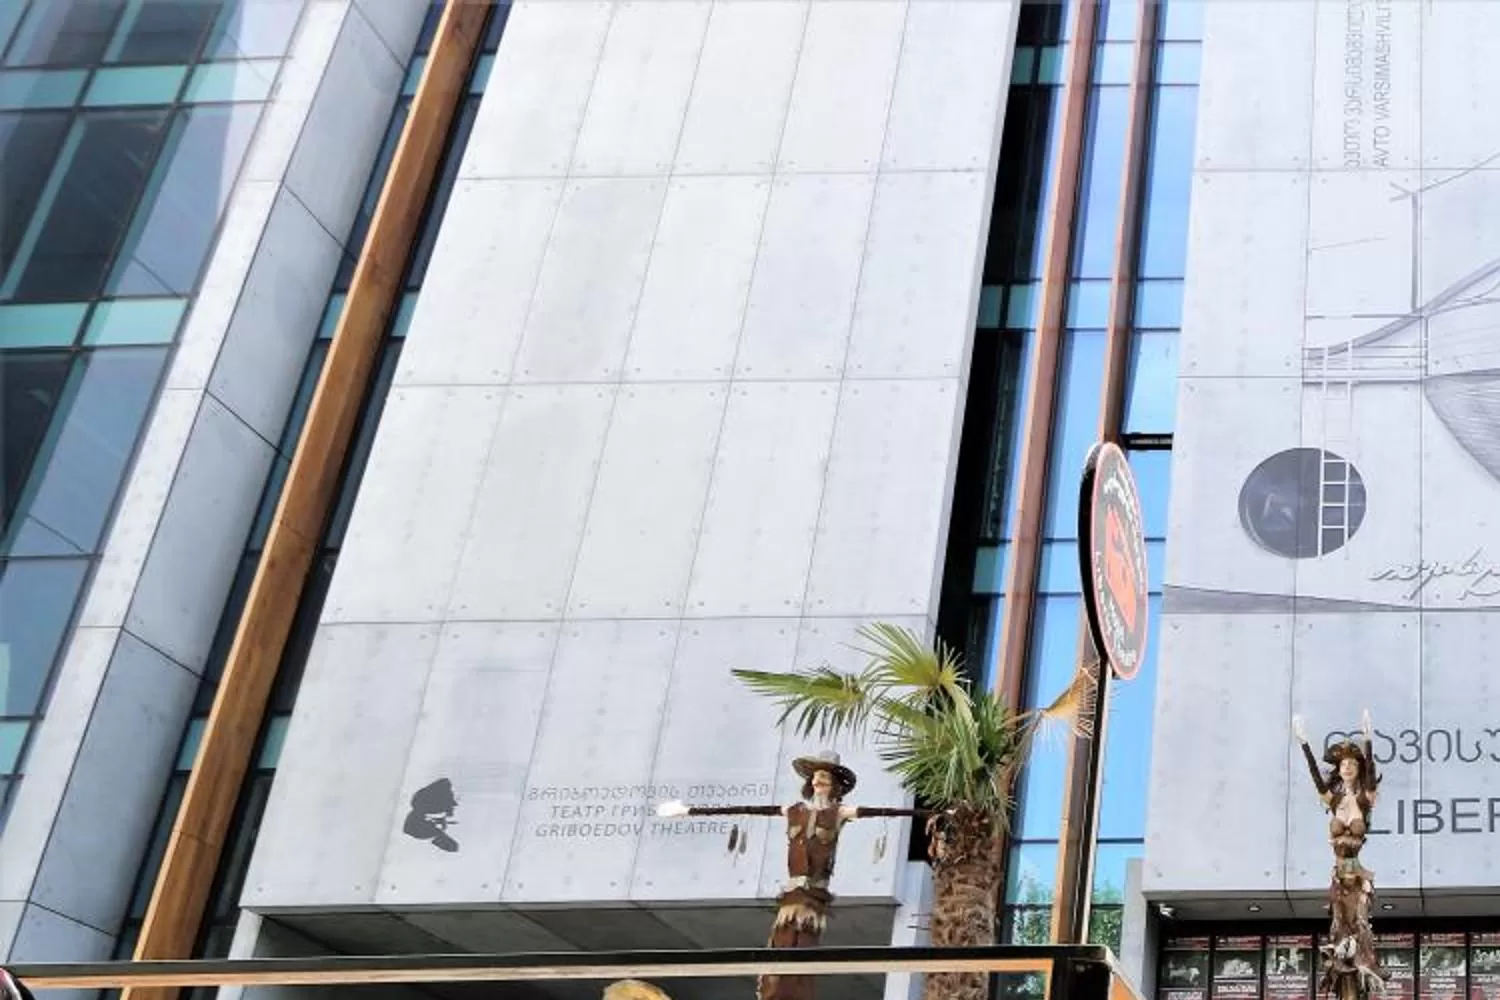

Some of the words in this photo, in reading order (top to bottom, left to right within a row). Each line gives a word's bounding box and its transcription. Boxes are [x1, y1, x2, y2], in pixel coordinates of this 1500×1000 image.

[1372, 125, 1392, 168] AVTO
[534, 823, 644, 838] GRIBOEDOV
[650, 821, 730, 836] THEATRE
